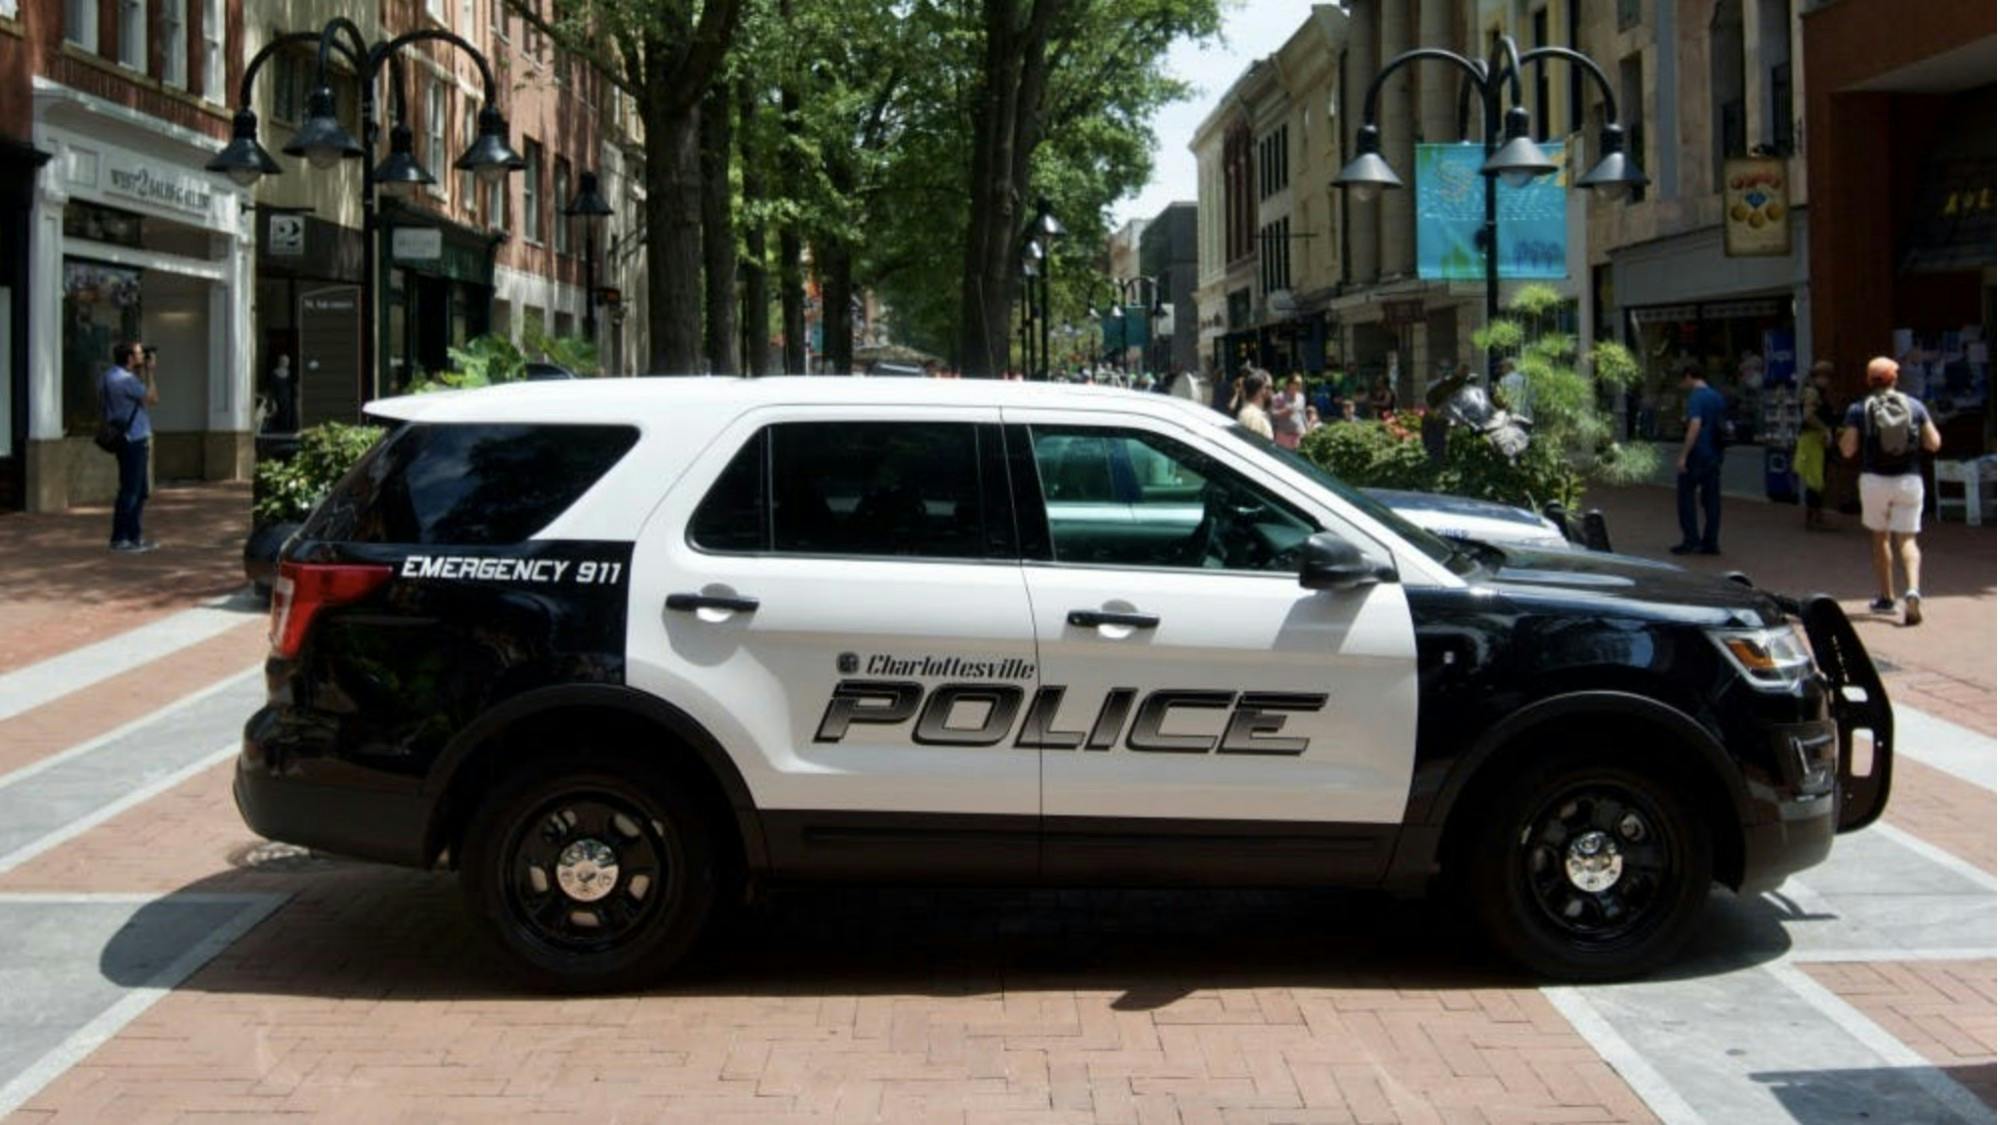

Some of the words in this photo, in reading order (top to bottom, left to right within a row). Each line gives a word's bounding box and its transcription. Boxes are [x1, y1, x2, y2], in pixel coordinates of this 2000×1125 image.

[401, 556, 570, 582] EMERGENCY
[575, 561, 622, 584] 911
[866, 654, 1037, 680] Charlottesville
[812, 679, 1329, 756] POLICE
